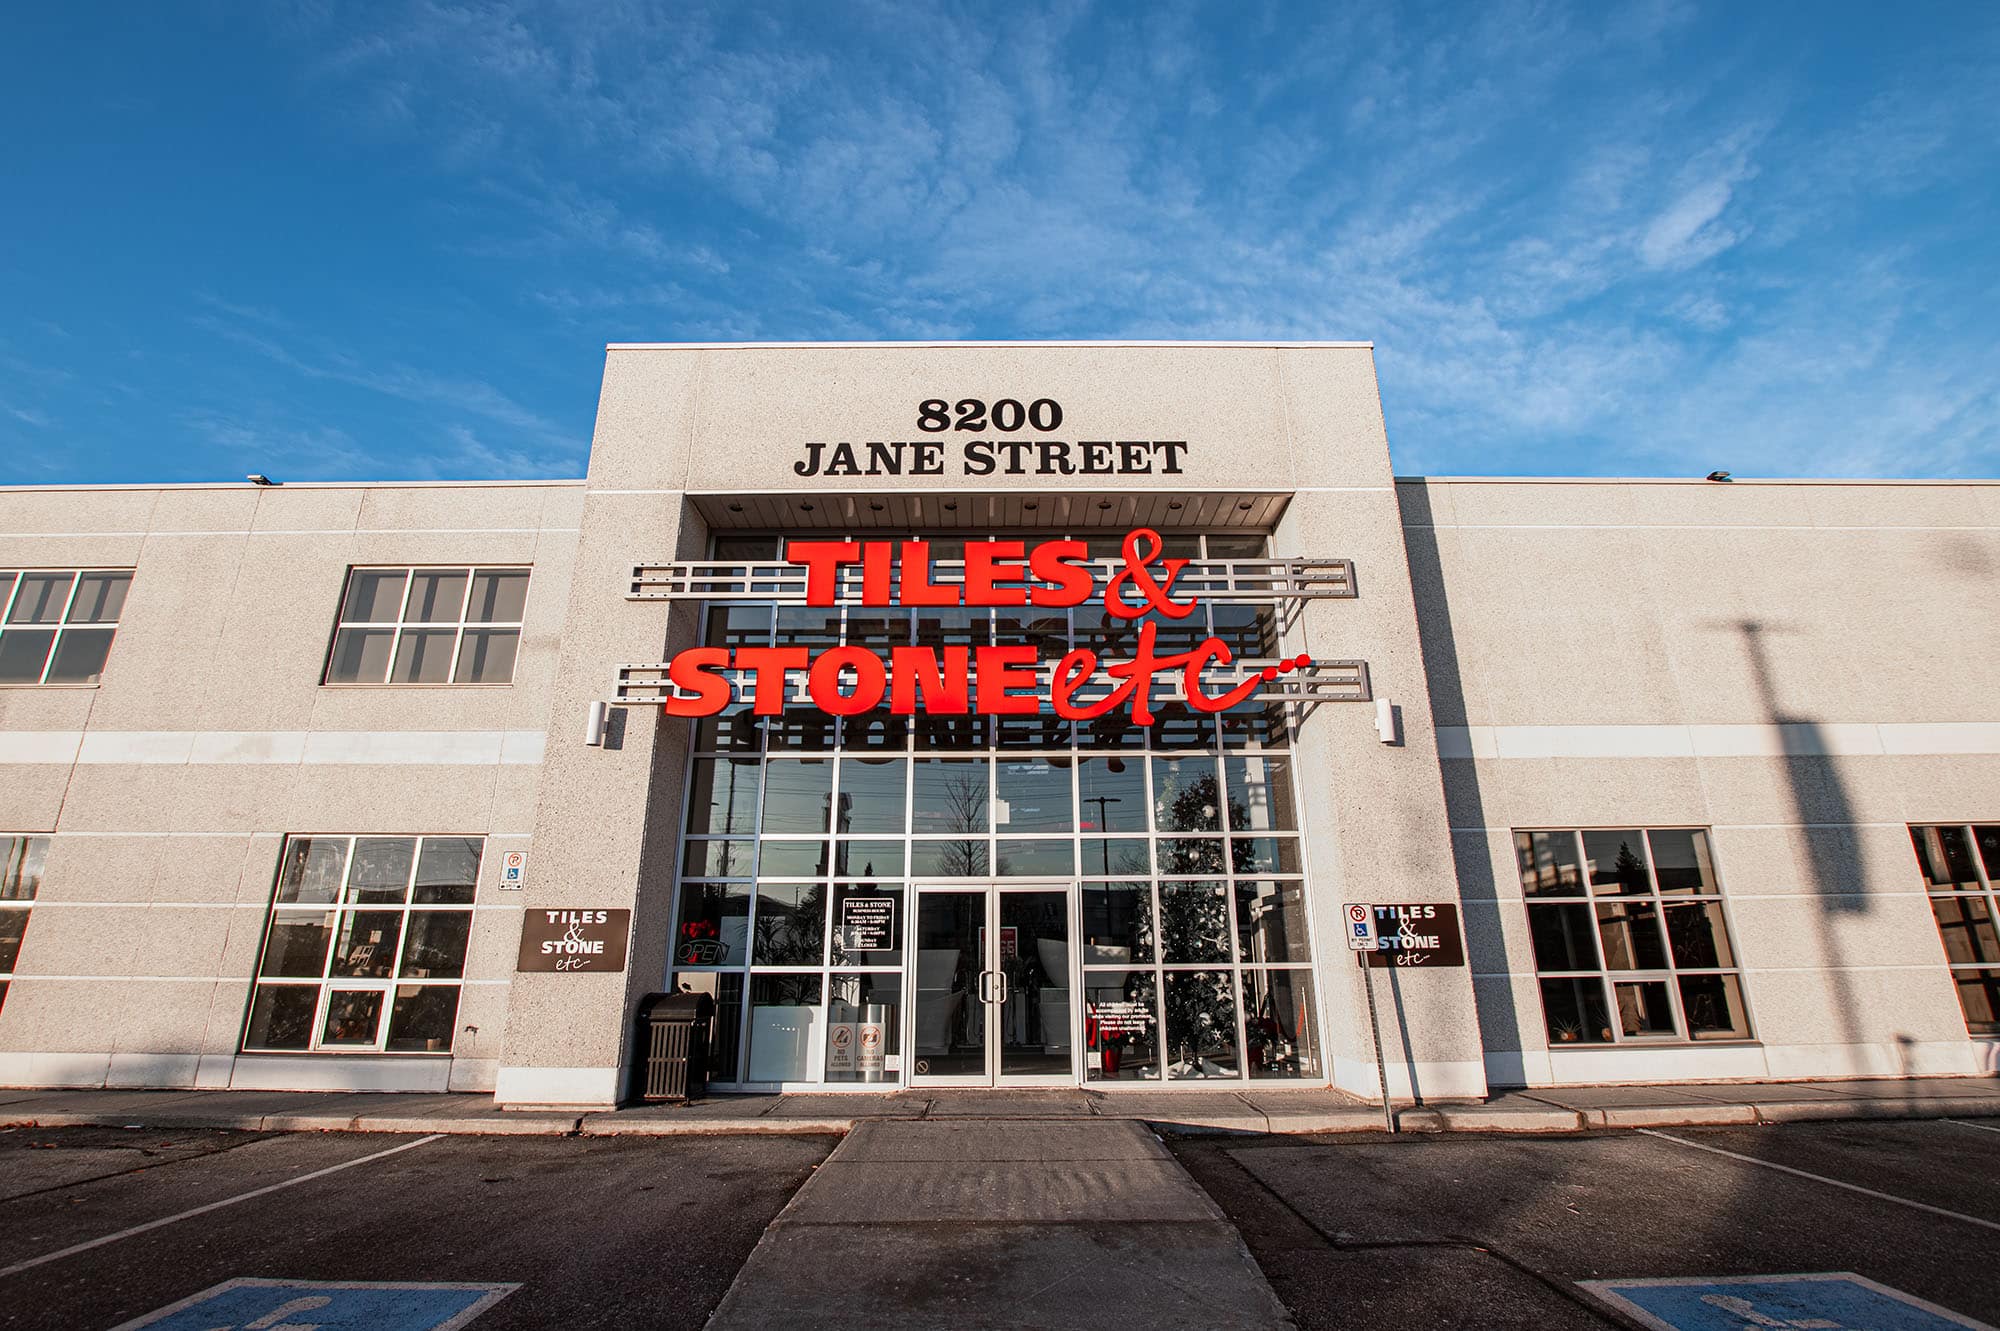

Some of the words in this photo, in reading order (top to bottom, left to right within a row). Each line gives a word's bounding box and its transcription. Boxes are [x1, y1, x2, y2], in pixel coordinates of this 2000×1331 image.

[917, 399, 1064, 432] 8200
[794, 441, 944, 477] JANE
[963, 440, 1188, 475] STREET
[787, 541, 1093, 607] TILES
[1104, 528, 1198, 620] &
[665, 645, 1040, 718] STONE
[546, 911, 607, 924] TILES
[1374, 906, 1436, 919] TILES
[563, 921, 585, 943] &
[1397, 917, 1418, 938] &
[541, 940, 604, 954] STONE
[678, 943, 730, 961] OPEN
[1378, 935, 1440, 949] STONE
